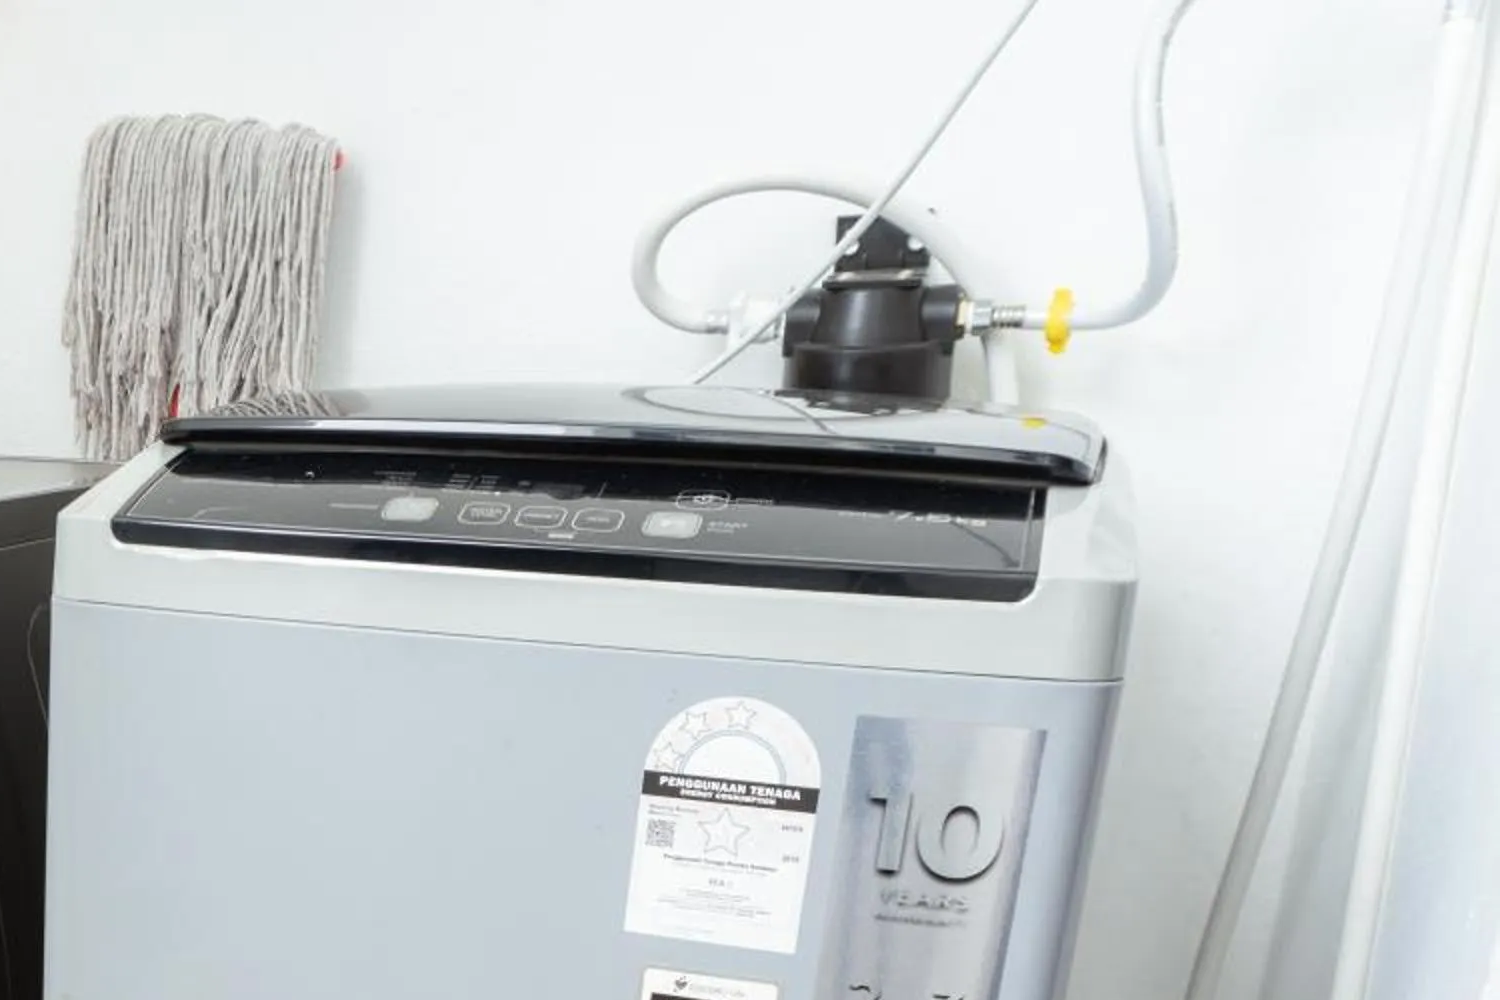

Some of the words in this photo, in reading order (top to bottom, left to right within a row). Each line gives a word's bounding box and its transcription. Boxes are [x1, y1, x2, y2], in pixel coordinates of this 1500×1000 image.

[658, 775, 747, 795] PENGGUNAAN
[749, 785, 802, 802] TENAGA
[867, 786, 1006, 885] 10
[879, 888, 970, 914] YEARS
